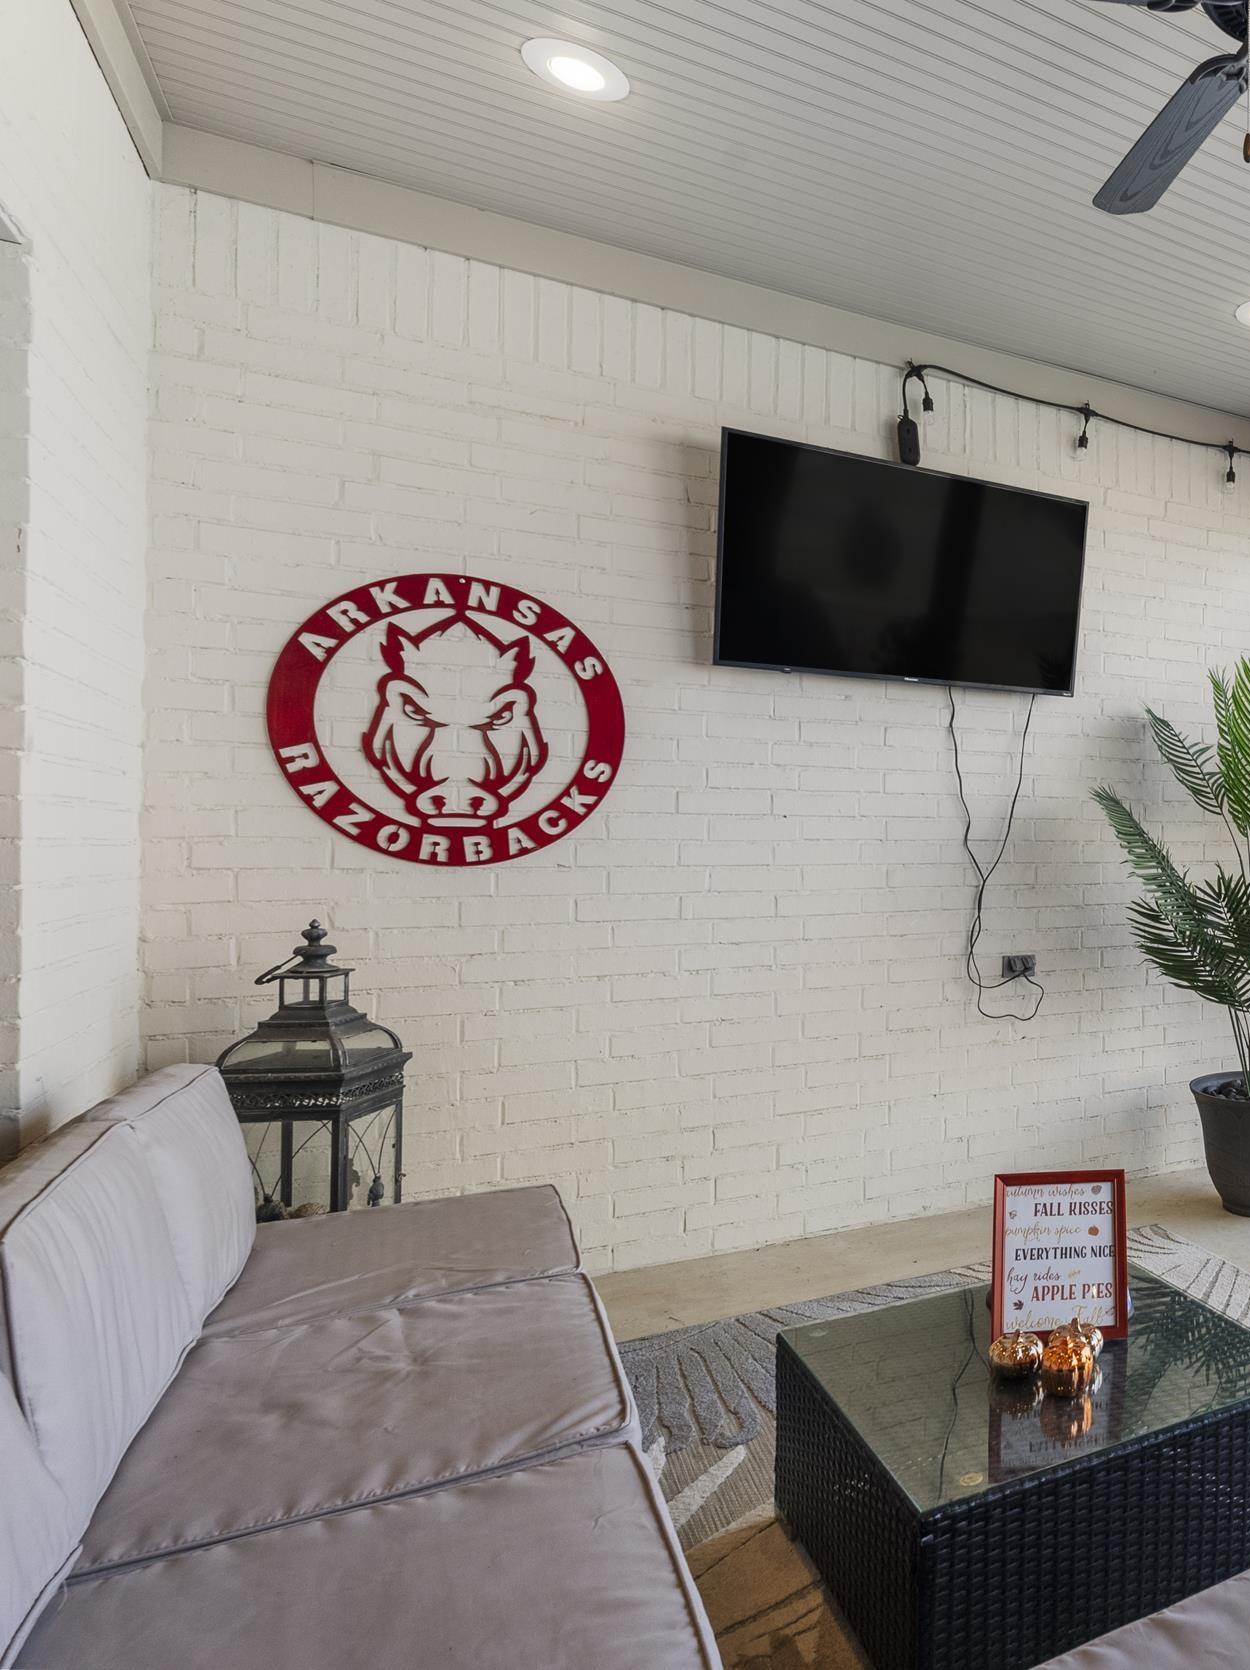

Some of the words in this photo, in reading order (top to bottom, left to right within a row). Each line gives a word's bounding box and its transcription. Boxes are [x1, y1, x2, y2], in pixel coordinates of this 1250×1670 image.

[298, 577, 603, 681] ARKANSAS
[278, 741, 613, 863] RAZORBACKS
[1048, 1184, 1085, 1200] wishes
[1034, 1202, 1064, 1217] FALL
[1069, 1201, 1113, 1216] KISSES
[1004, 1221, 1050, 1245] pumpkin
[1054, 1225, 1082, 1244] spice
[1015, 1246, 1087, 1261] EVERYTHING
[1091, 1244, 1115, 1259] NICE
[1007, 1267, 1028, 1294] hay
[1033, 1266, 1060, 1281] rides
[1031, 1283, 1076, 1302] APPLE
[1006, 1310, 1060, 1330] welcome
